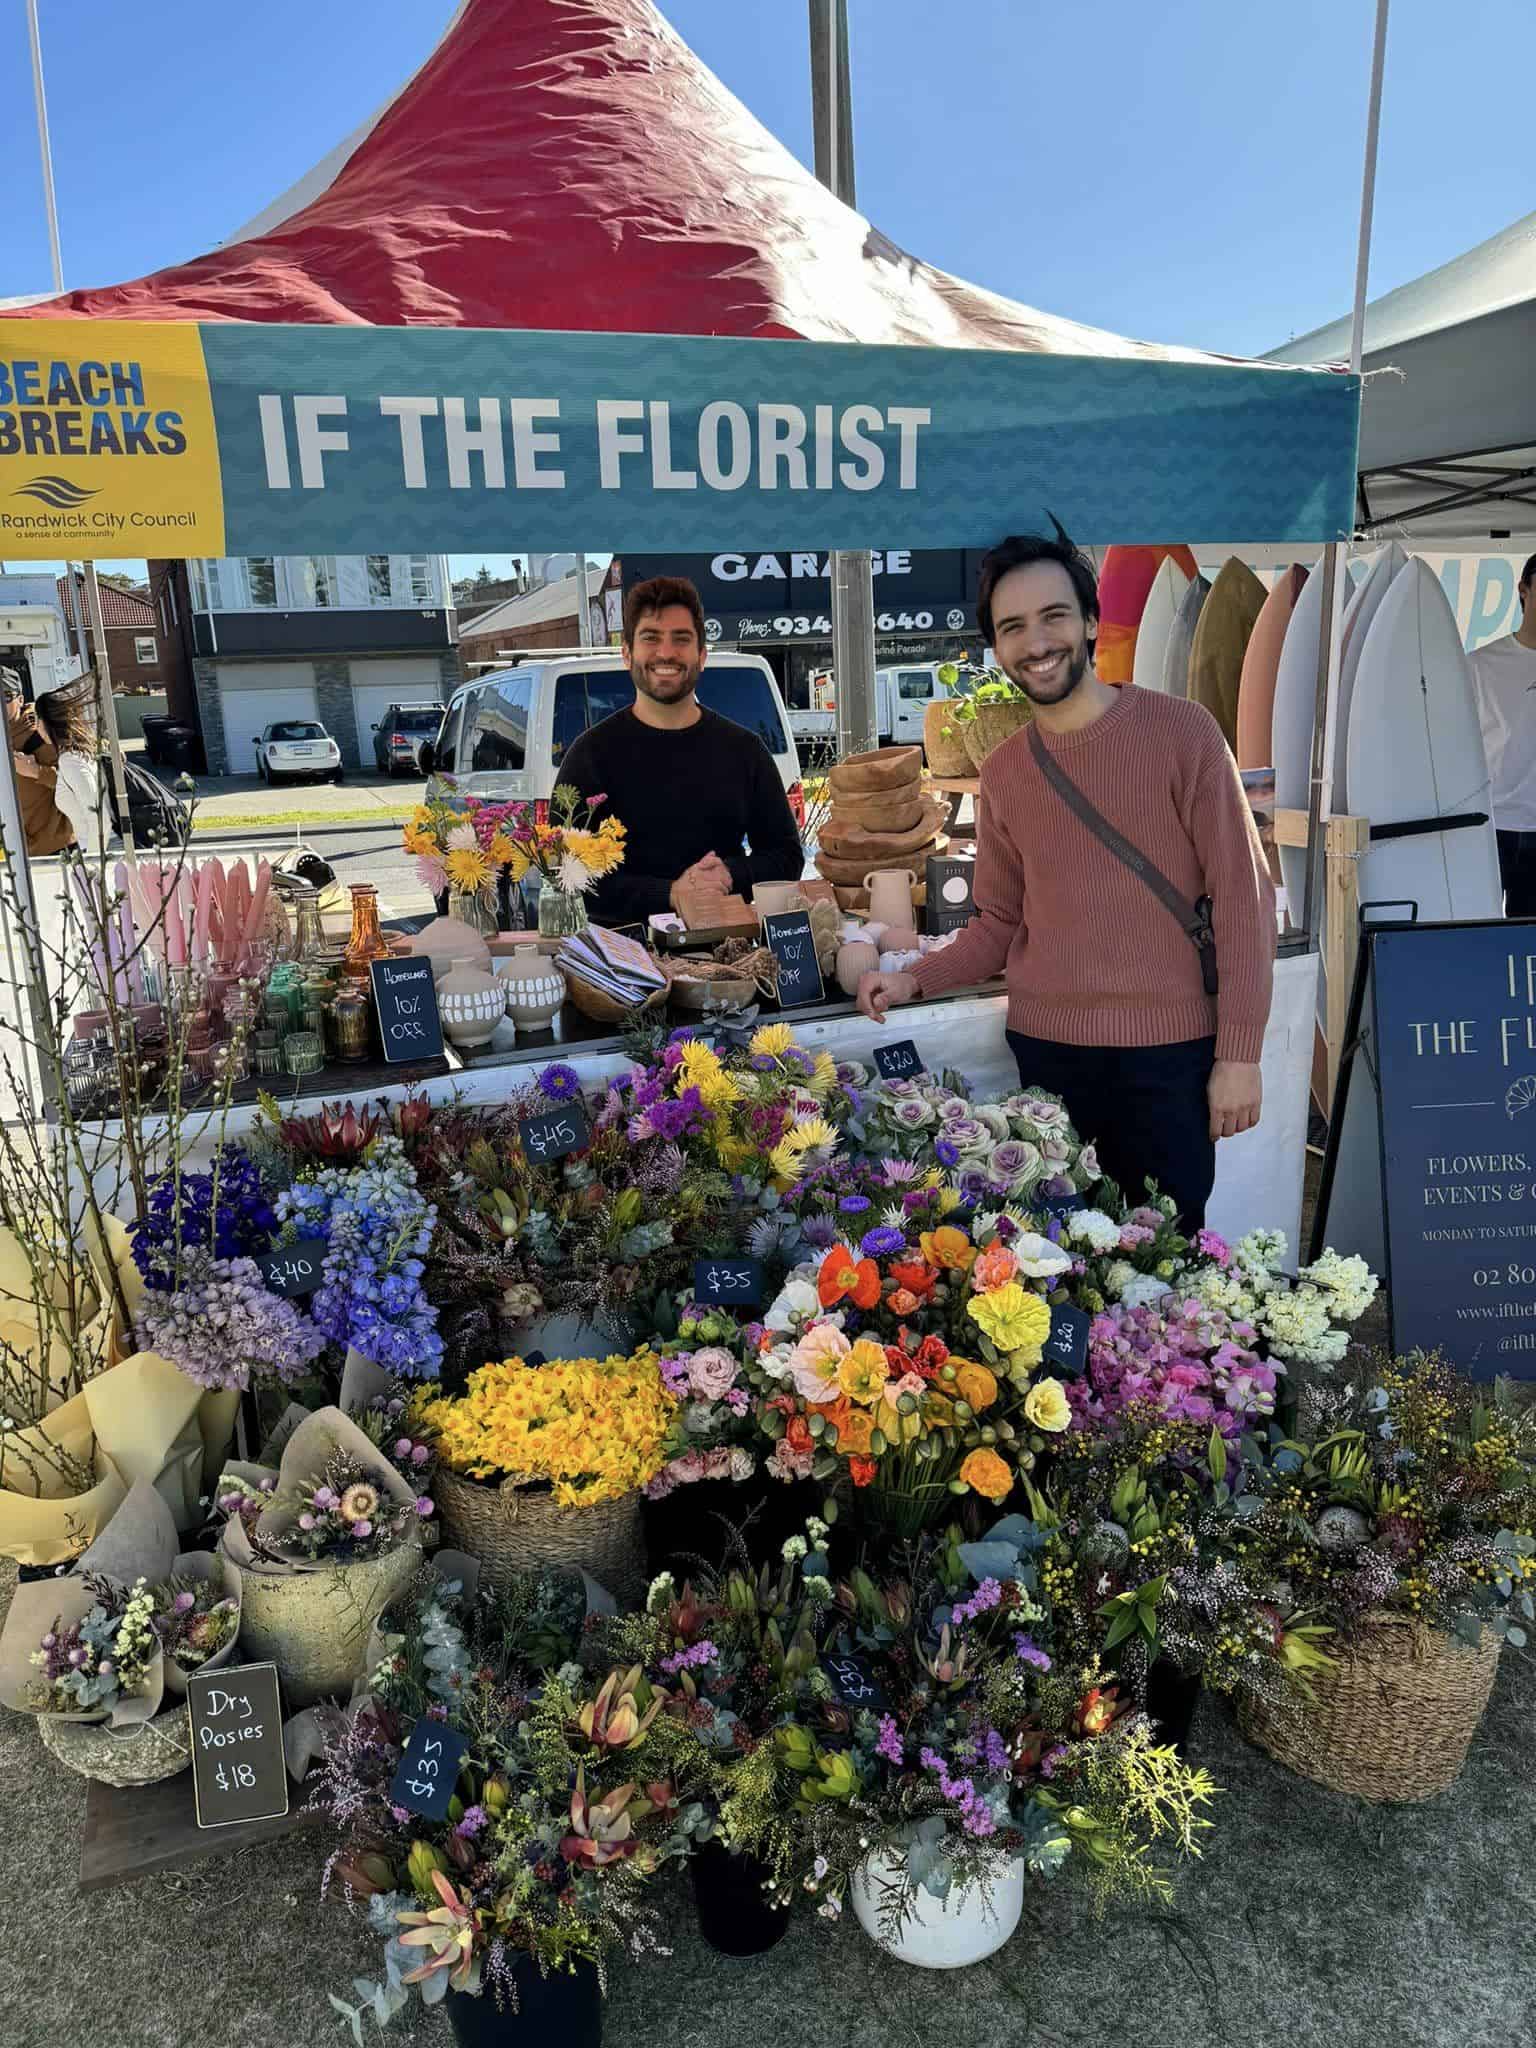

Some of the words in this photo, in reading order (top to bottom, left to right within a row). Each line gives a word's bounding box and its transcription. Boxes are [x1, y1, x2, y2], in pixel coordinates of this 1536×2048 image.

[258, 395, 349, 489] IF
[380, 397, 566, 489] THE
[597, 400, 932, 491] FLORIST
[2, 513, 88, 528] Randwick
[92, 512, 126, 530] City
[130, 512, 197, 528] Council
[53, 530, 61, 538] of
[64, 529, 115, 539] community
[711, 550, 912, 582] GARE
[897, 644, 927, 655] Parade
[783, 941, 804, 960] 10%
[394, 995, 421, 1015] 10%
[1408, 1020, 1479, 1056] THE
[883, 1050, 914, 1072] $20
[529, 1120, 576, 1156] $45
[1424, 1185, 1502, 1206] EVENTS
[1508, 1183, 1525, 1201] &
[1423, 1228, 1475, 1241] MONDAY
[1477, 1227, 1496, 1239] TO
[270, 1259, 313, 1288] $40
[707, 1266, 751, 1293] $35
[1473, 1268, 1501, 1286] 02
[1053, 1322, 1074, 1353] $20
[830, 1659, 875, 1699] $35
[206, 1690, 253, 1719] Dry
[200, 1724, 264, 1750] Posies
[215, 1763, 256, 1791] $18
[405, 1737, 442, 1799] $35
